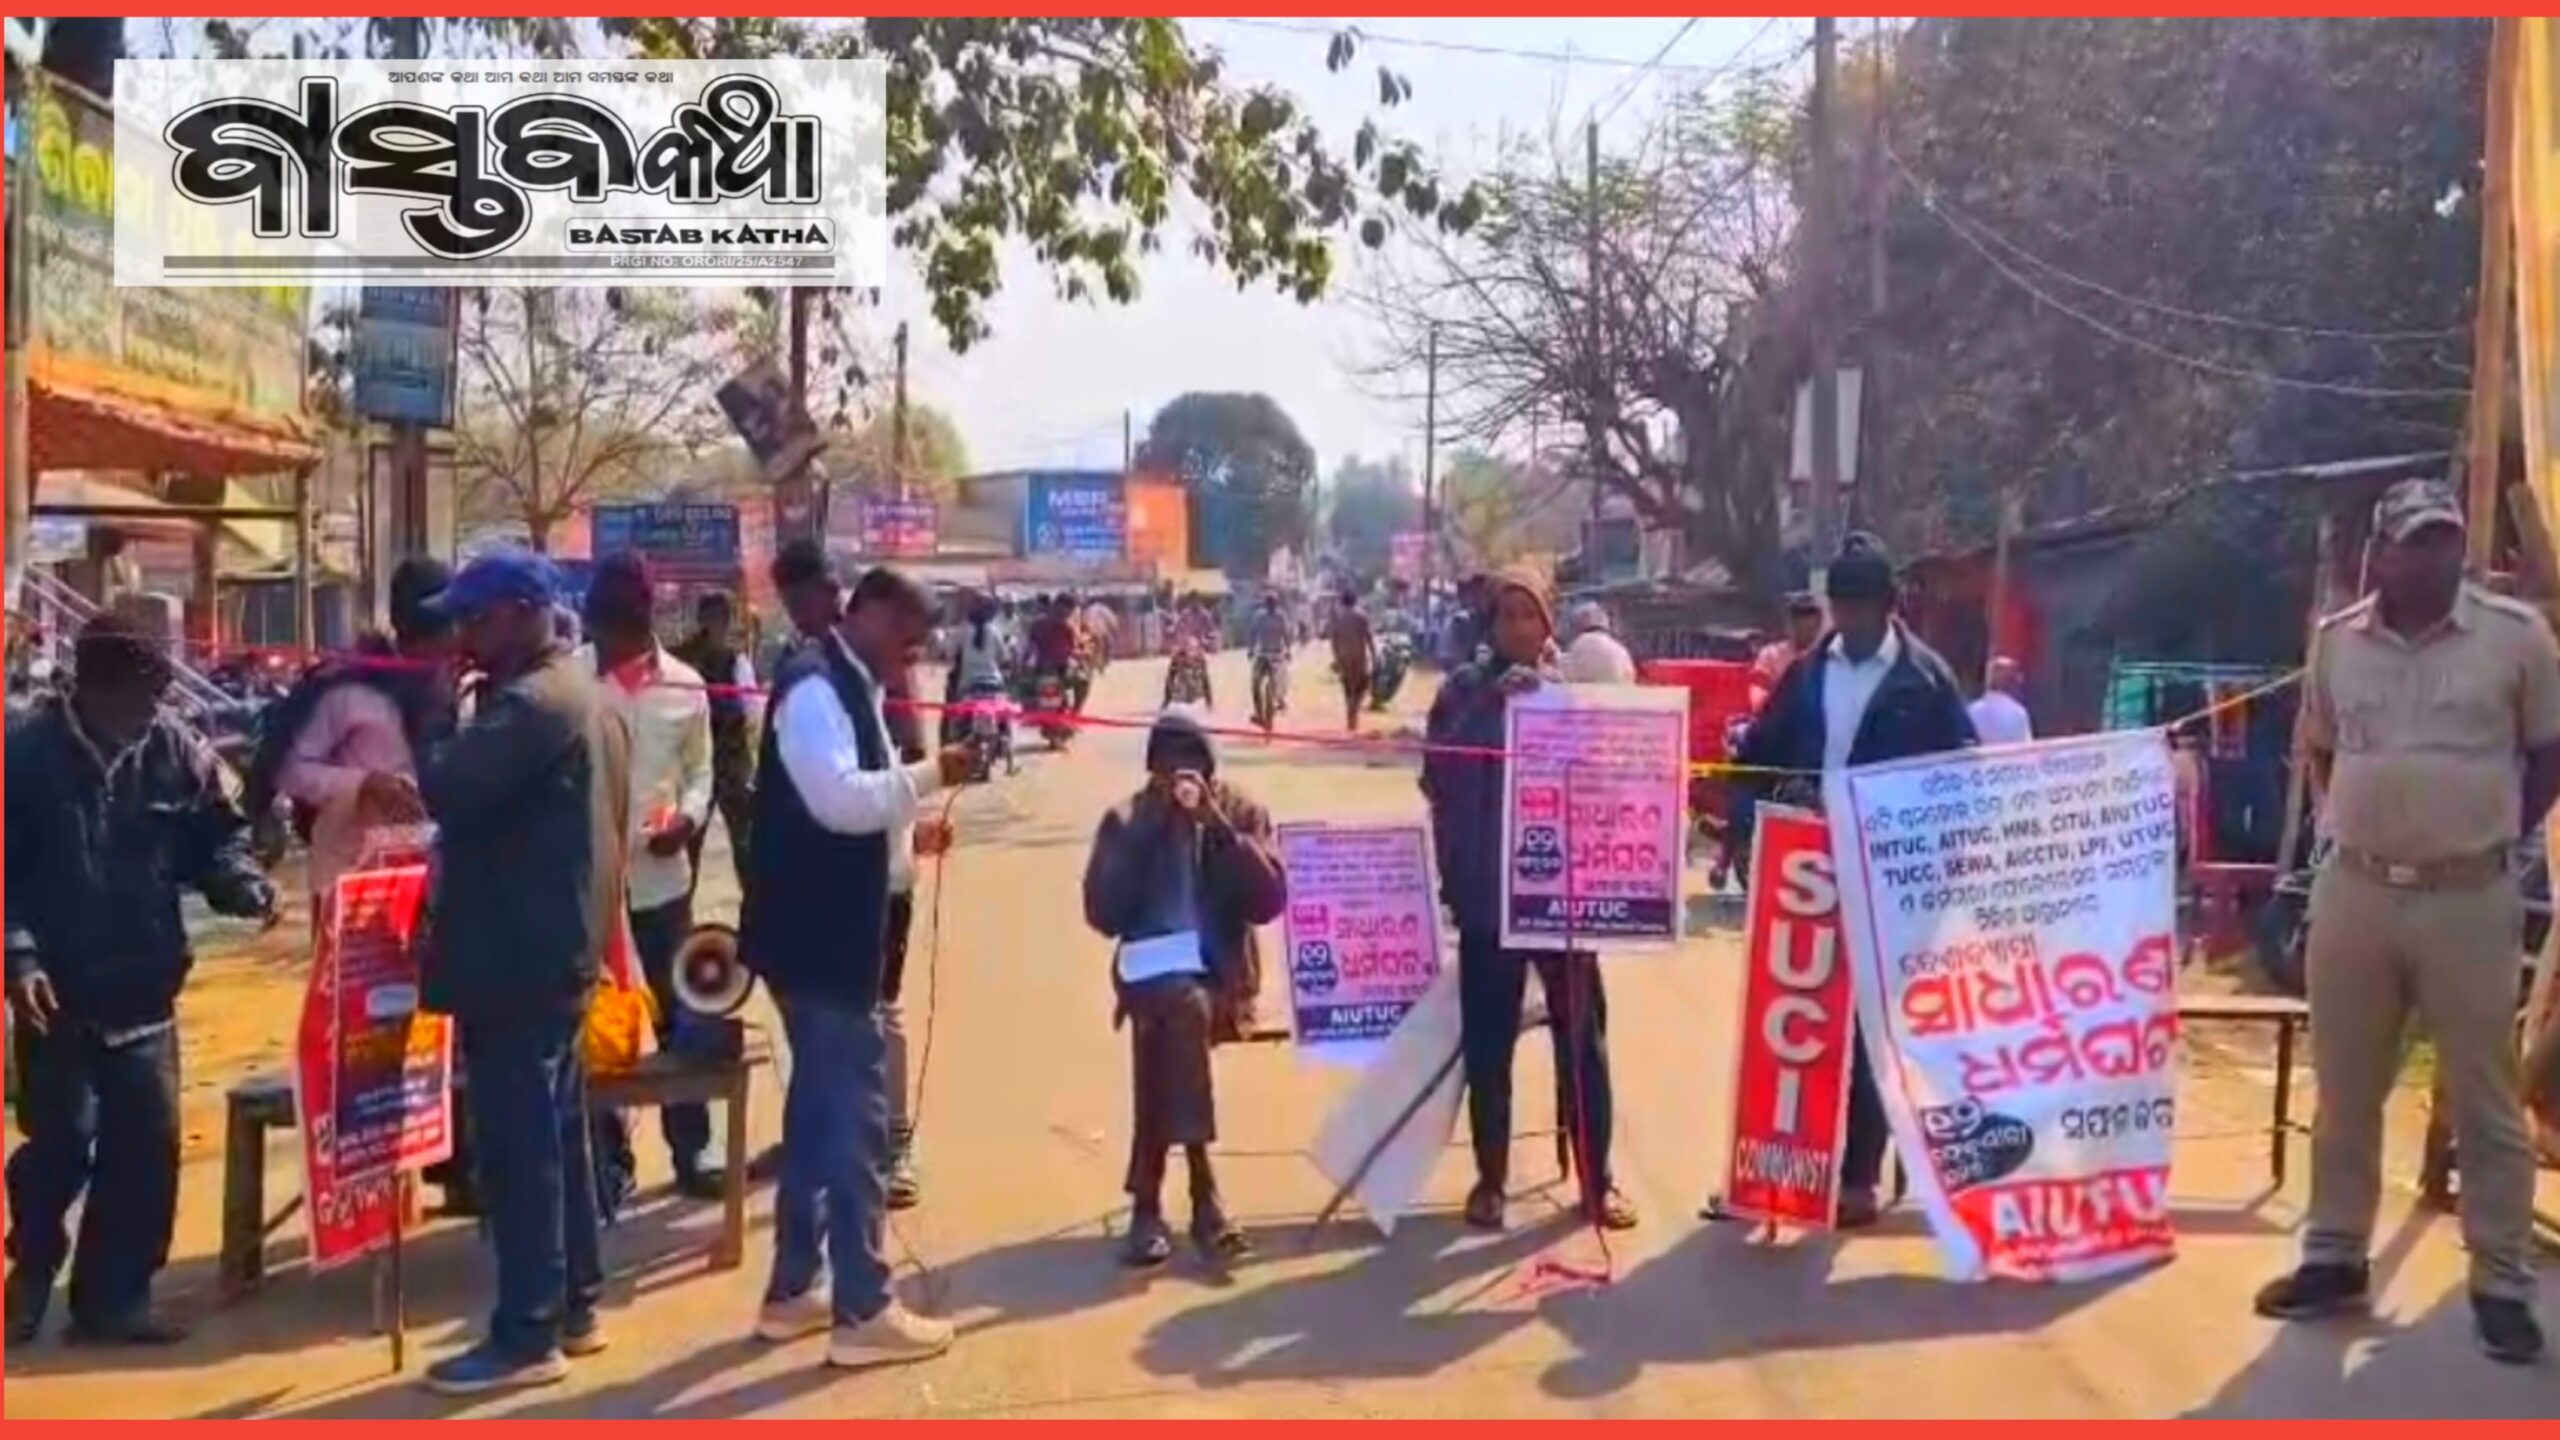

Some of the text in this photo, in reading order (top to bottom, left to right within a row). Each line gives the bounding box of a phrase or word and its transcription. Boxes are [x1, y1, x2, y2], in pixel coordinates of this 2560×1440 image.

[1870, 835, 1932, 862] INTUC,
[1940, 825, 1998, 852] AITUC,
[2050, 811, 2097, 833] CITU,
[1884, 863, 1941, 888] TUCC,
[2005, 842, 2076, 868] AICCTU,
[1547, 899, 1629, 919] AIUTUC
[1764, 850, 1838, 1133] SUCI
[1902, 932, 2174, 1037] ସାଧାରଣ
[1331, 1004, 1401, 1025] AIUTUC
[1735, 1136, 1829, 1192] COMMUNIST
